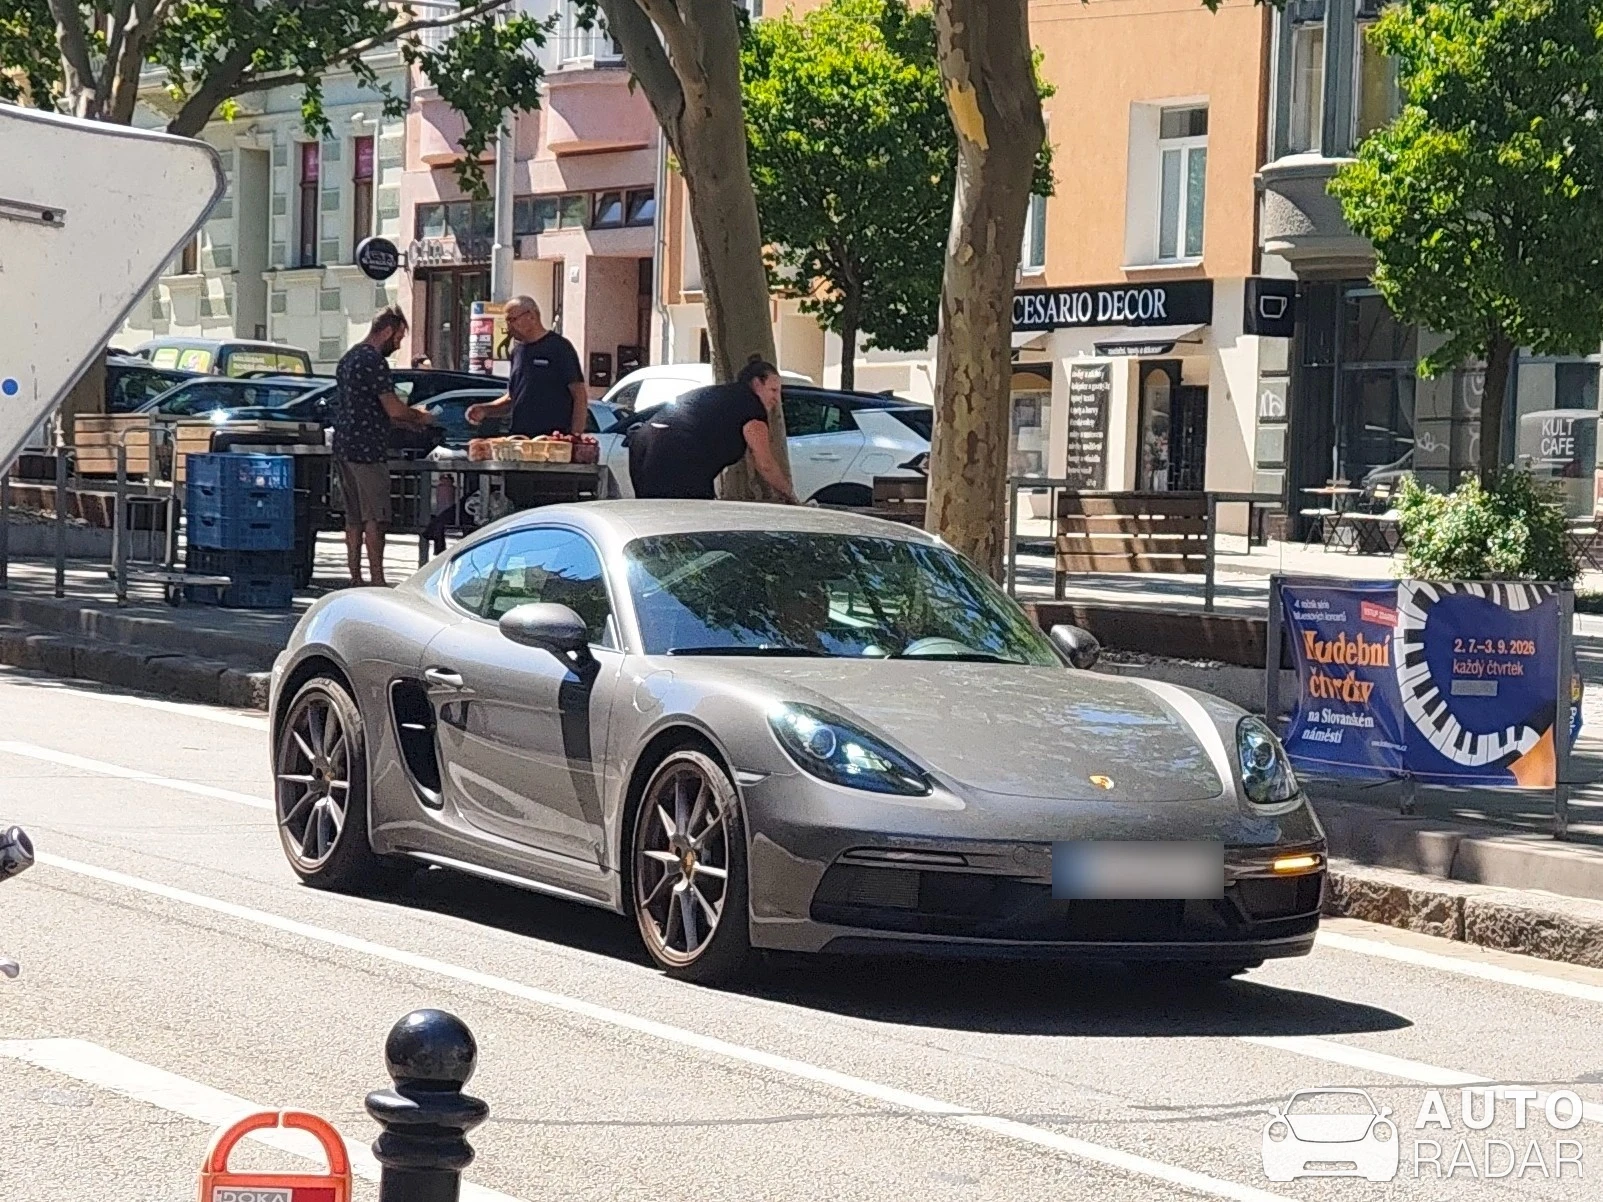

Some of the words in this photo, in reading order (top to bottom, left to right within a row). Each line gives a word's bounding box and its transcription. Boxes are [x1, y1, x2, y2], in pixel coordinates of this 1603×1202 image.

[1012, 291, 1093, 325] CESARIO
[1097, 288, 1168, 322] DECOR
[1541, 418, 1575, 436] KULT
[1541, 437, 1575, 456] CAFE
[1453, 638, 1466, 653] 2.
[1497, 639, 1508, 655] 9.
[1510, 640, 1536, 656] 2026
[1453, 658, 1486, 678] každý
[1486, 659, 1524, 676] čtvrtek
[1307, 711, 1320, 722] na
[1302, 726, 1344, 744] náměstí
